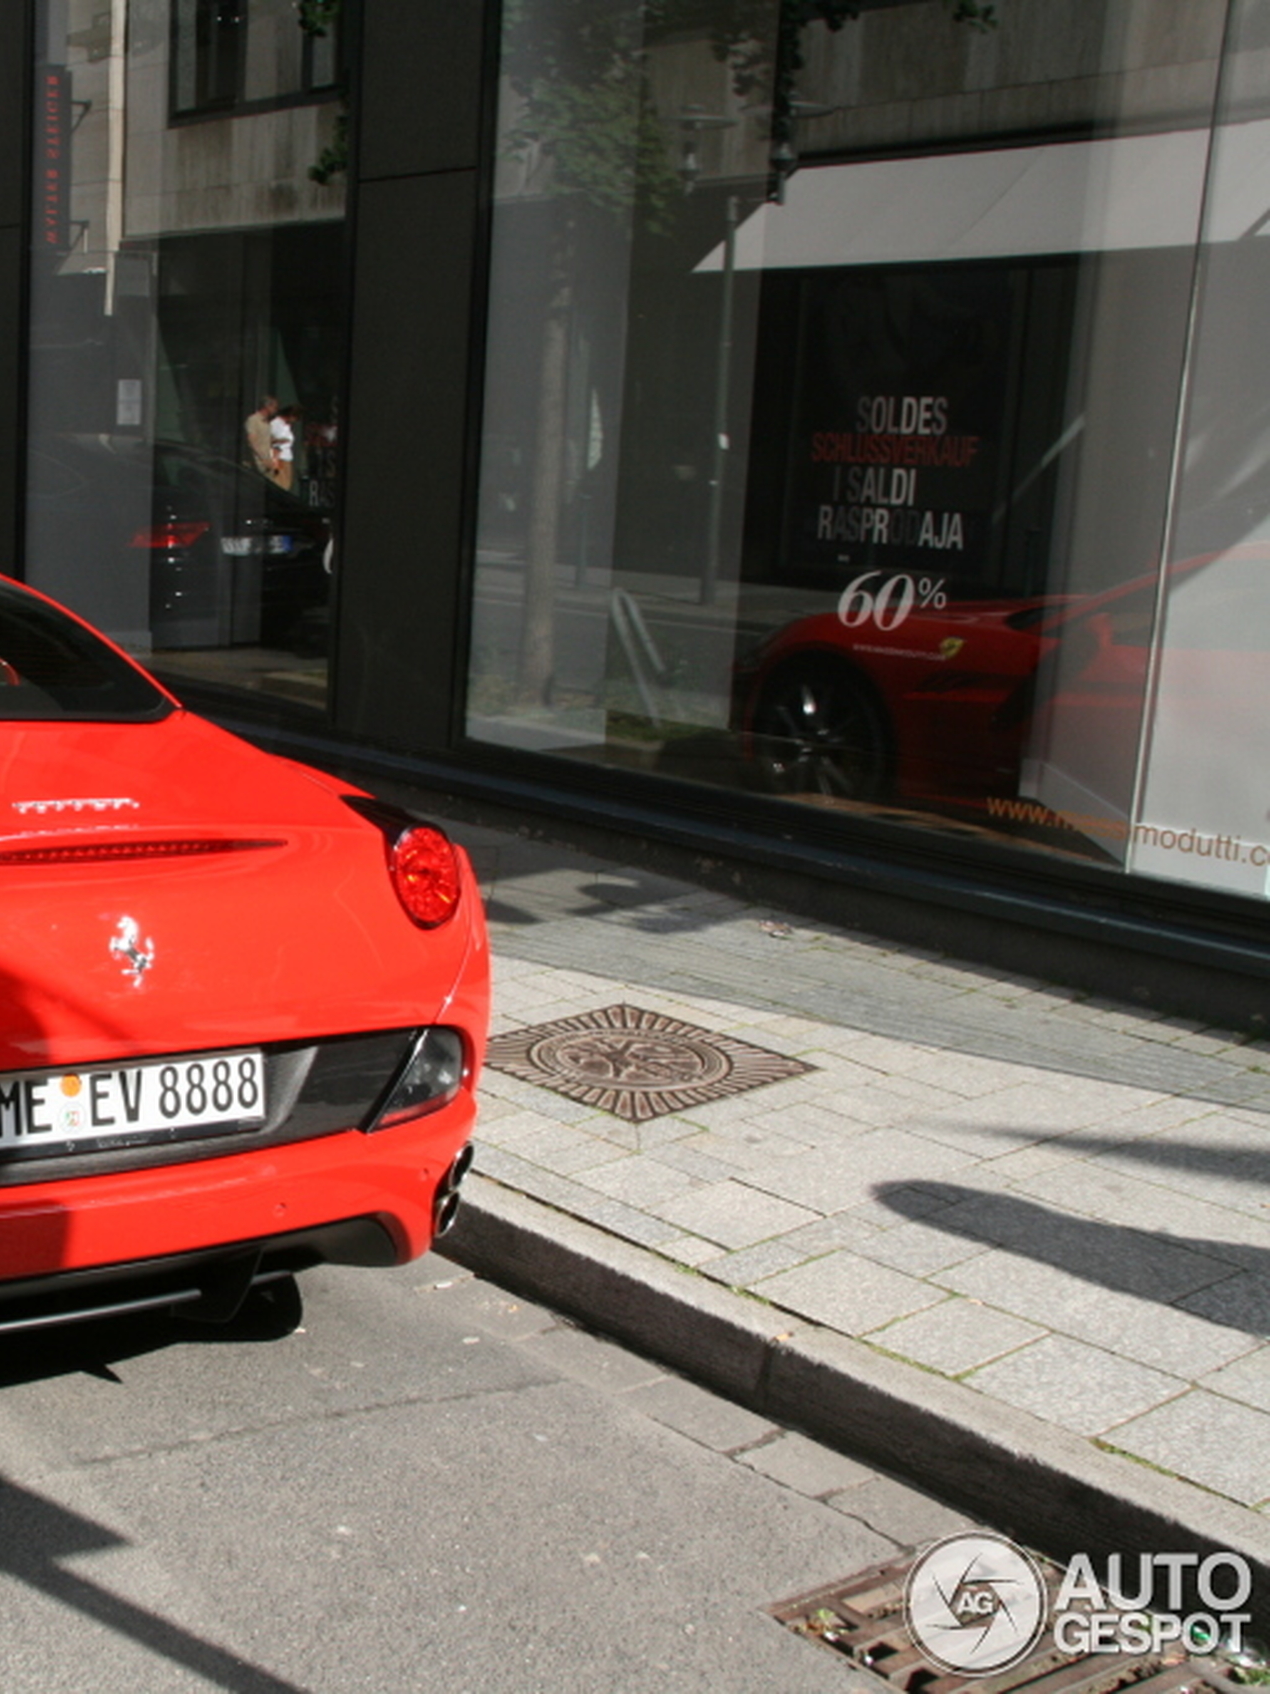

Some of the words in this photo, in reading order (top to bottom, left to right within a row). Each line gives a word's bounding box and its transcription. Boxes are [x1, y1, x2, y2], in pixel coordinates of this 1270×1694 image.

[856, 396, 948, 435] SOLDES
[812, 433, 979, 467] SCHLUSSVERKAUF
[846, 466, 918, 507] SALDI
[818, 505, 963, 550] RASPRODAJA
[89, 1068, 143, 1128] EV
[159, 1057, 258, 1118] 8888
